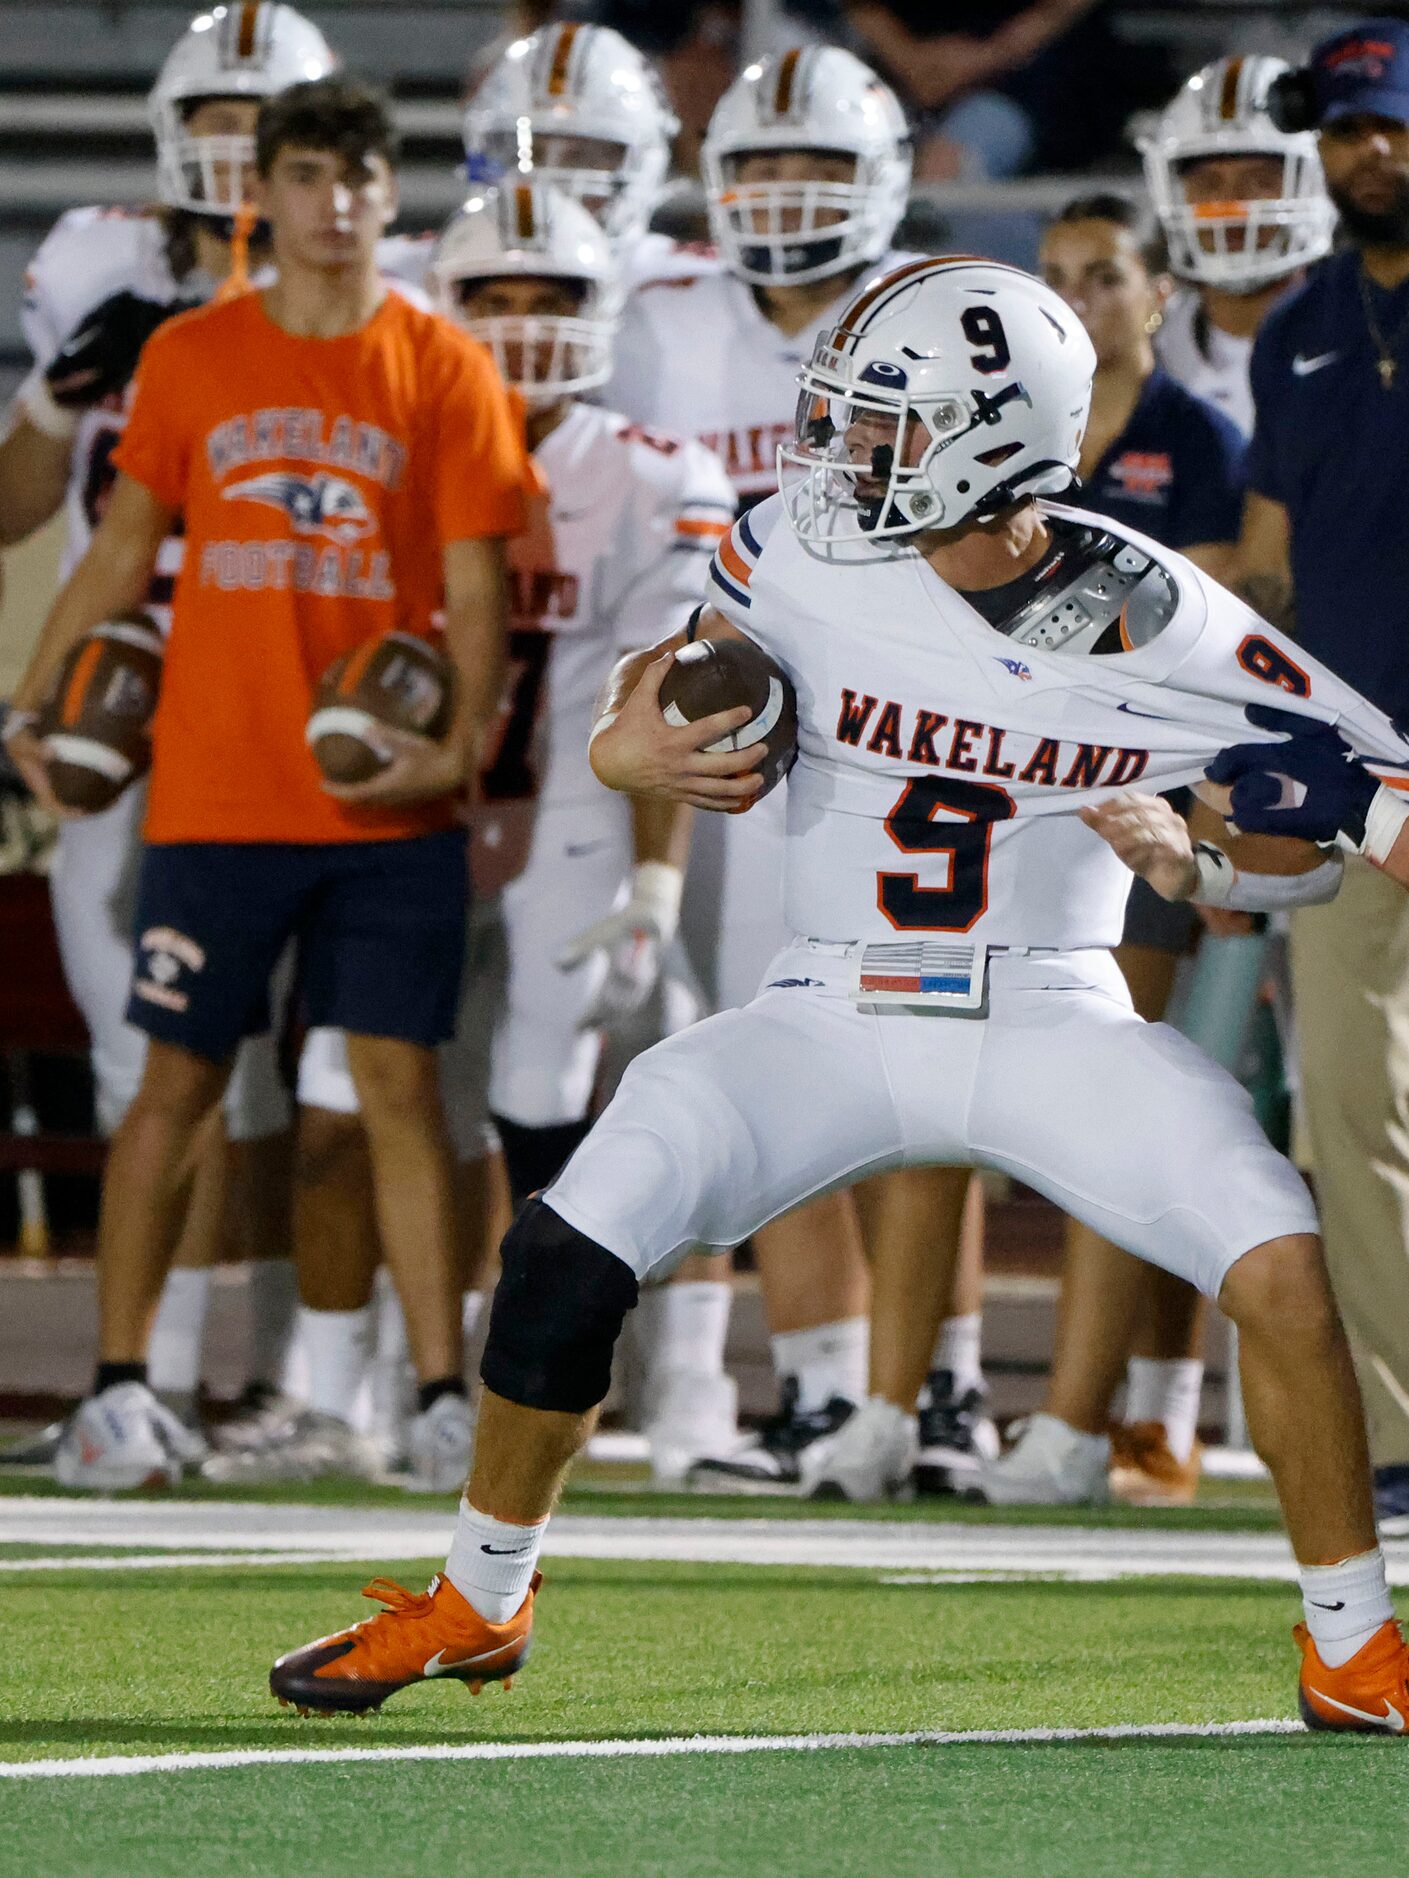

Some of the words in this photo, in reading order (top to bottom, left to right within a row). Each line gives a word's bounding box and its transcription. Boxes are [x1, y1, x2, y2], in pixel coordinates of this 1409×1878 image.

[959, 305, 1012, 375] 9
[1234, 634, 1312, 699] 9
[834, 687, 1150, 789] WAKELAND
[876, 773, 1017, 934] 9
